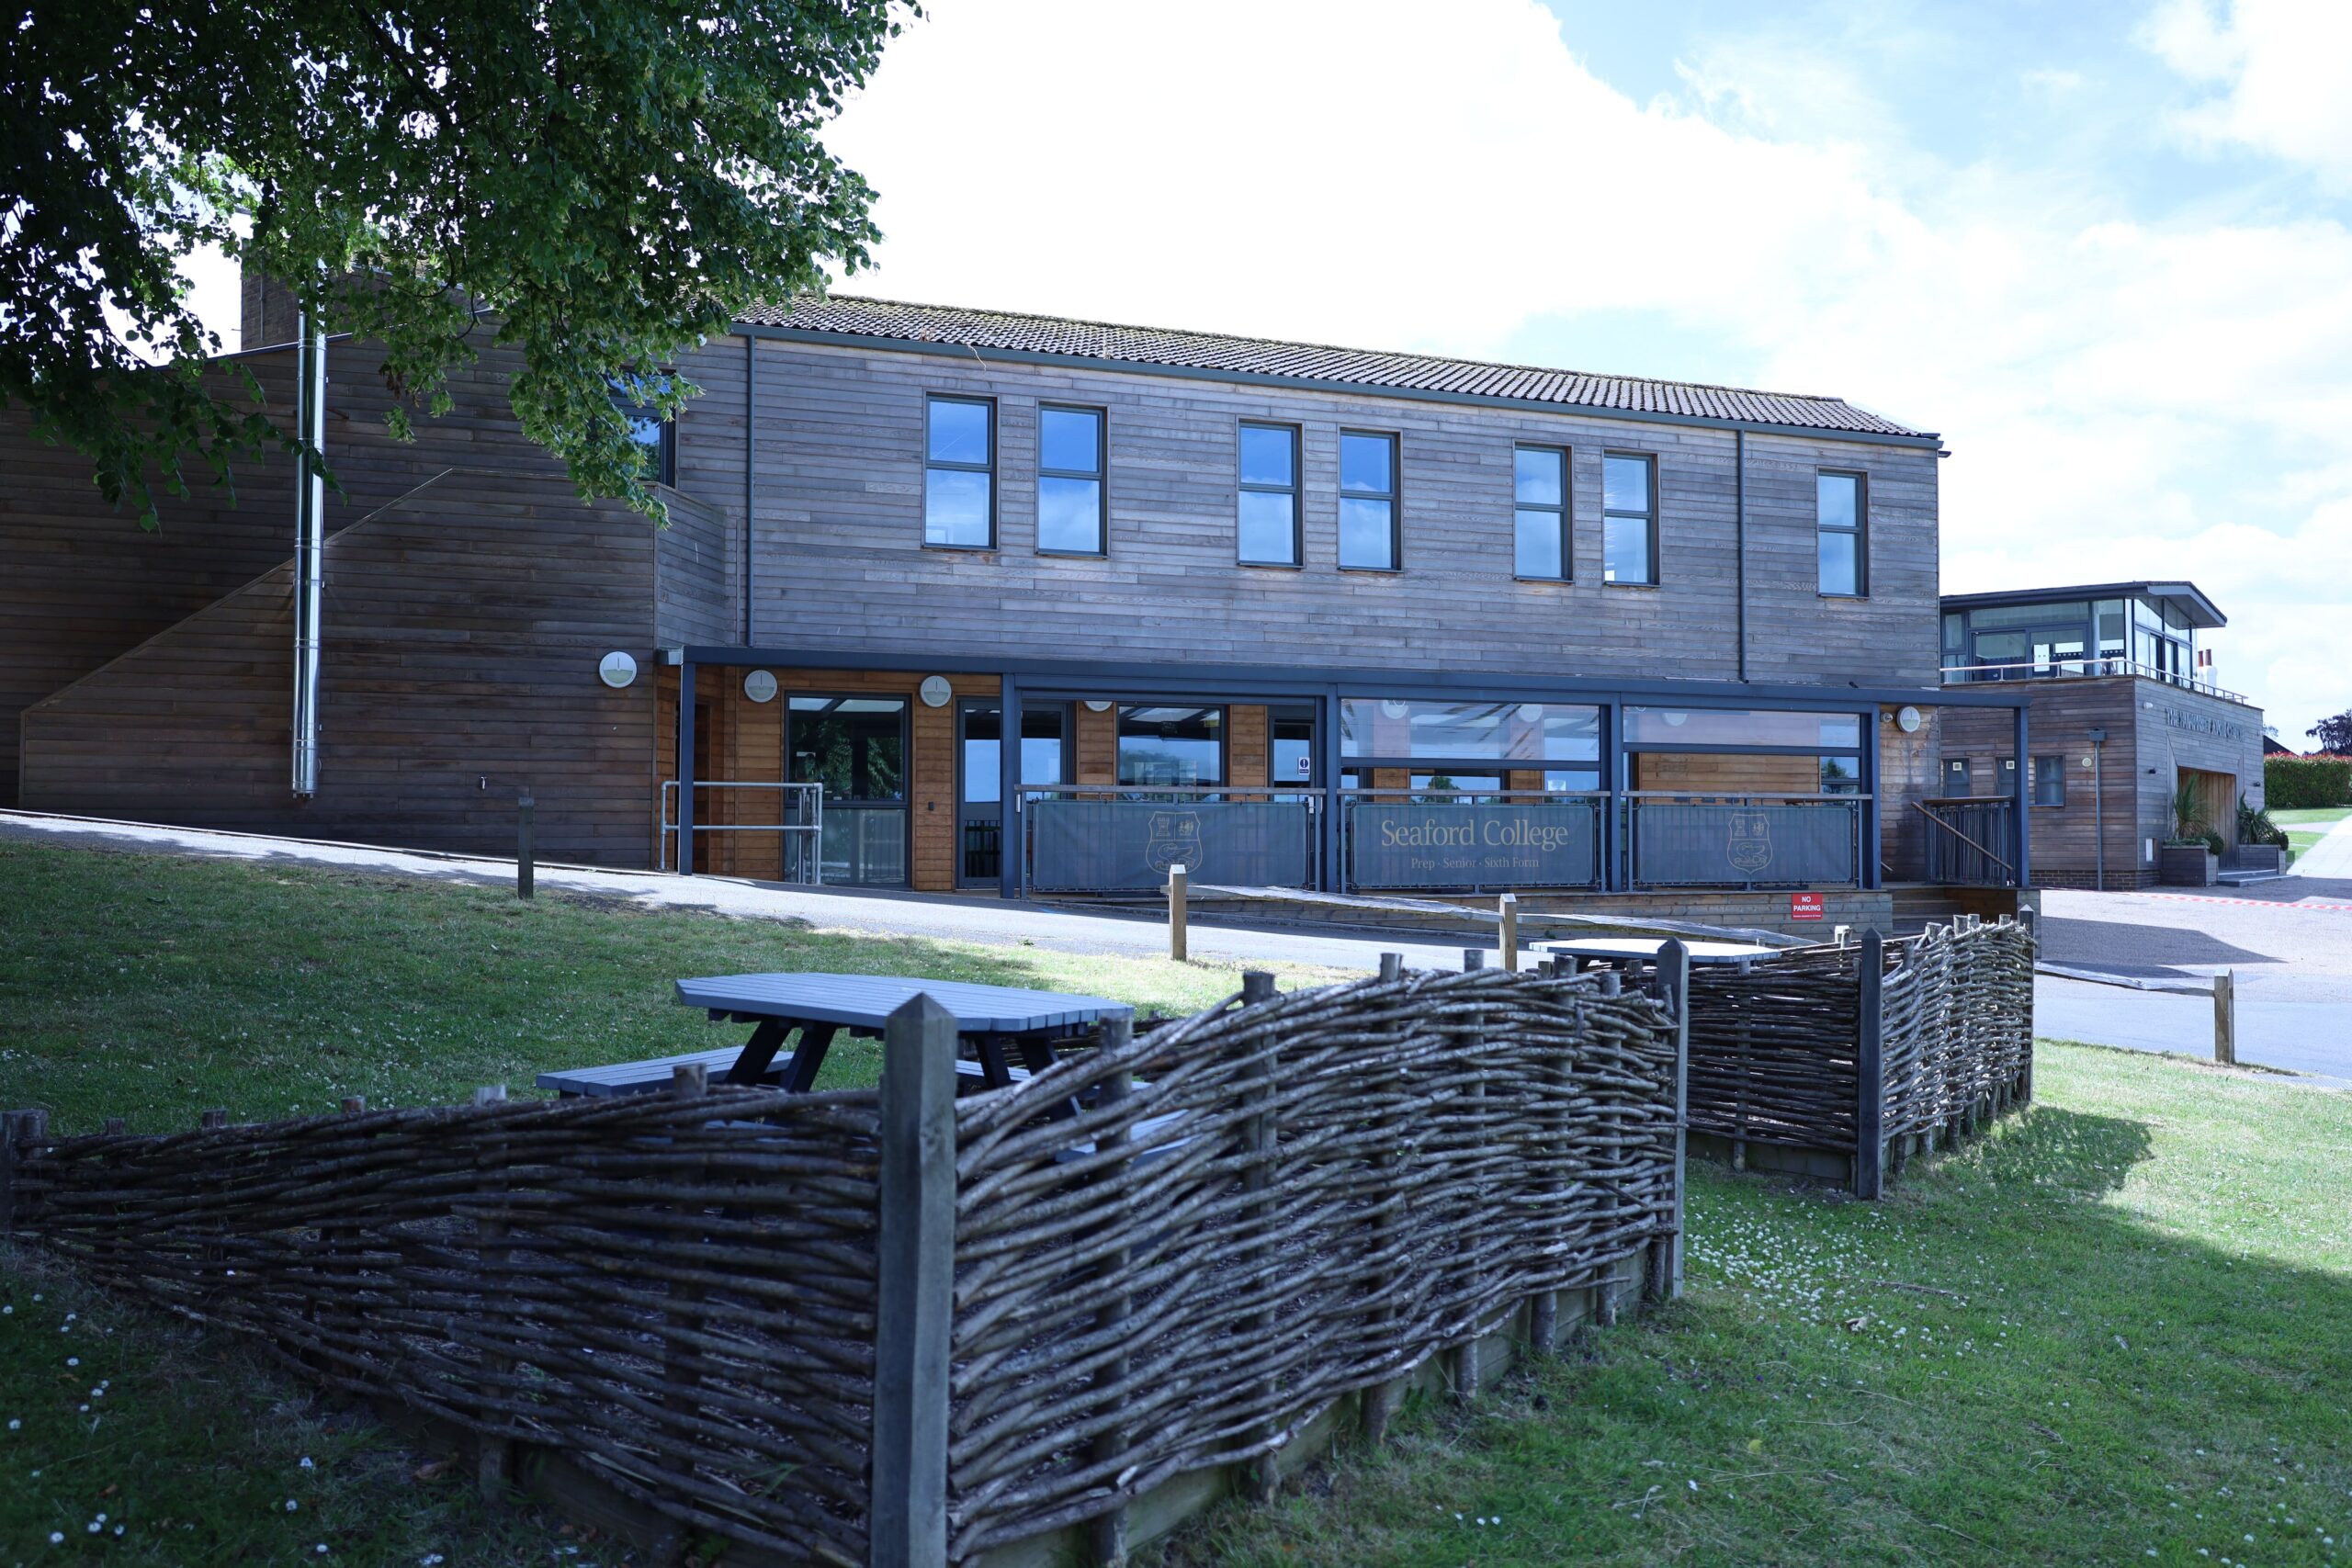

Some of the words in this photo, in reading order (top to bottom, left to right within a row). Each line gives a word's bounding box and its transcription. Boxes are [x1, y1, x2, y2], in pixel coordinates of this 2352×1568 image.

[1381, 818, 1475, 846] Seaford
[1484, 819, 1568, 852] College
[1411, 857, 1435, 871] Prep
[1442, 857, 1476, 868] Senior
[1484, 857, 1510, 868] Sixth
[1512, 857, 1539, 868] Form
